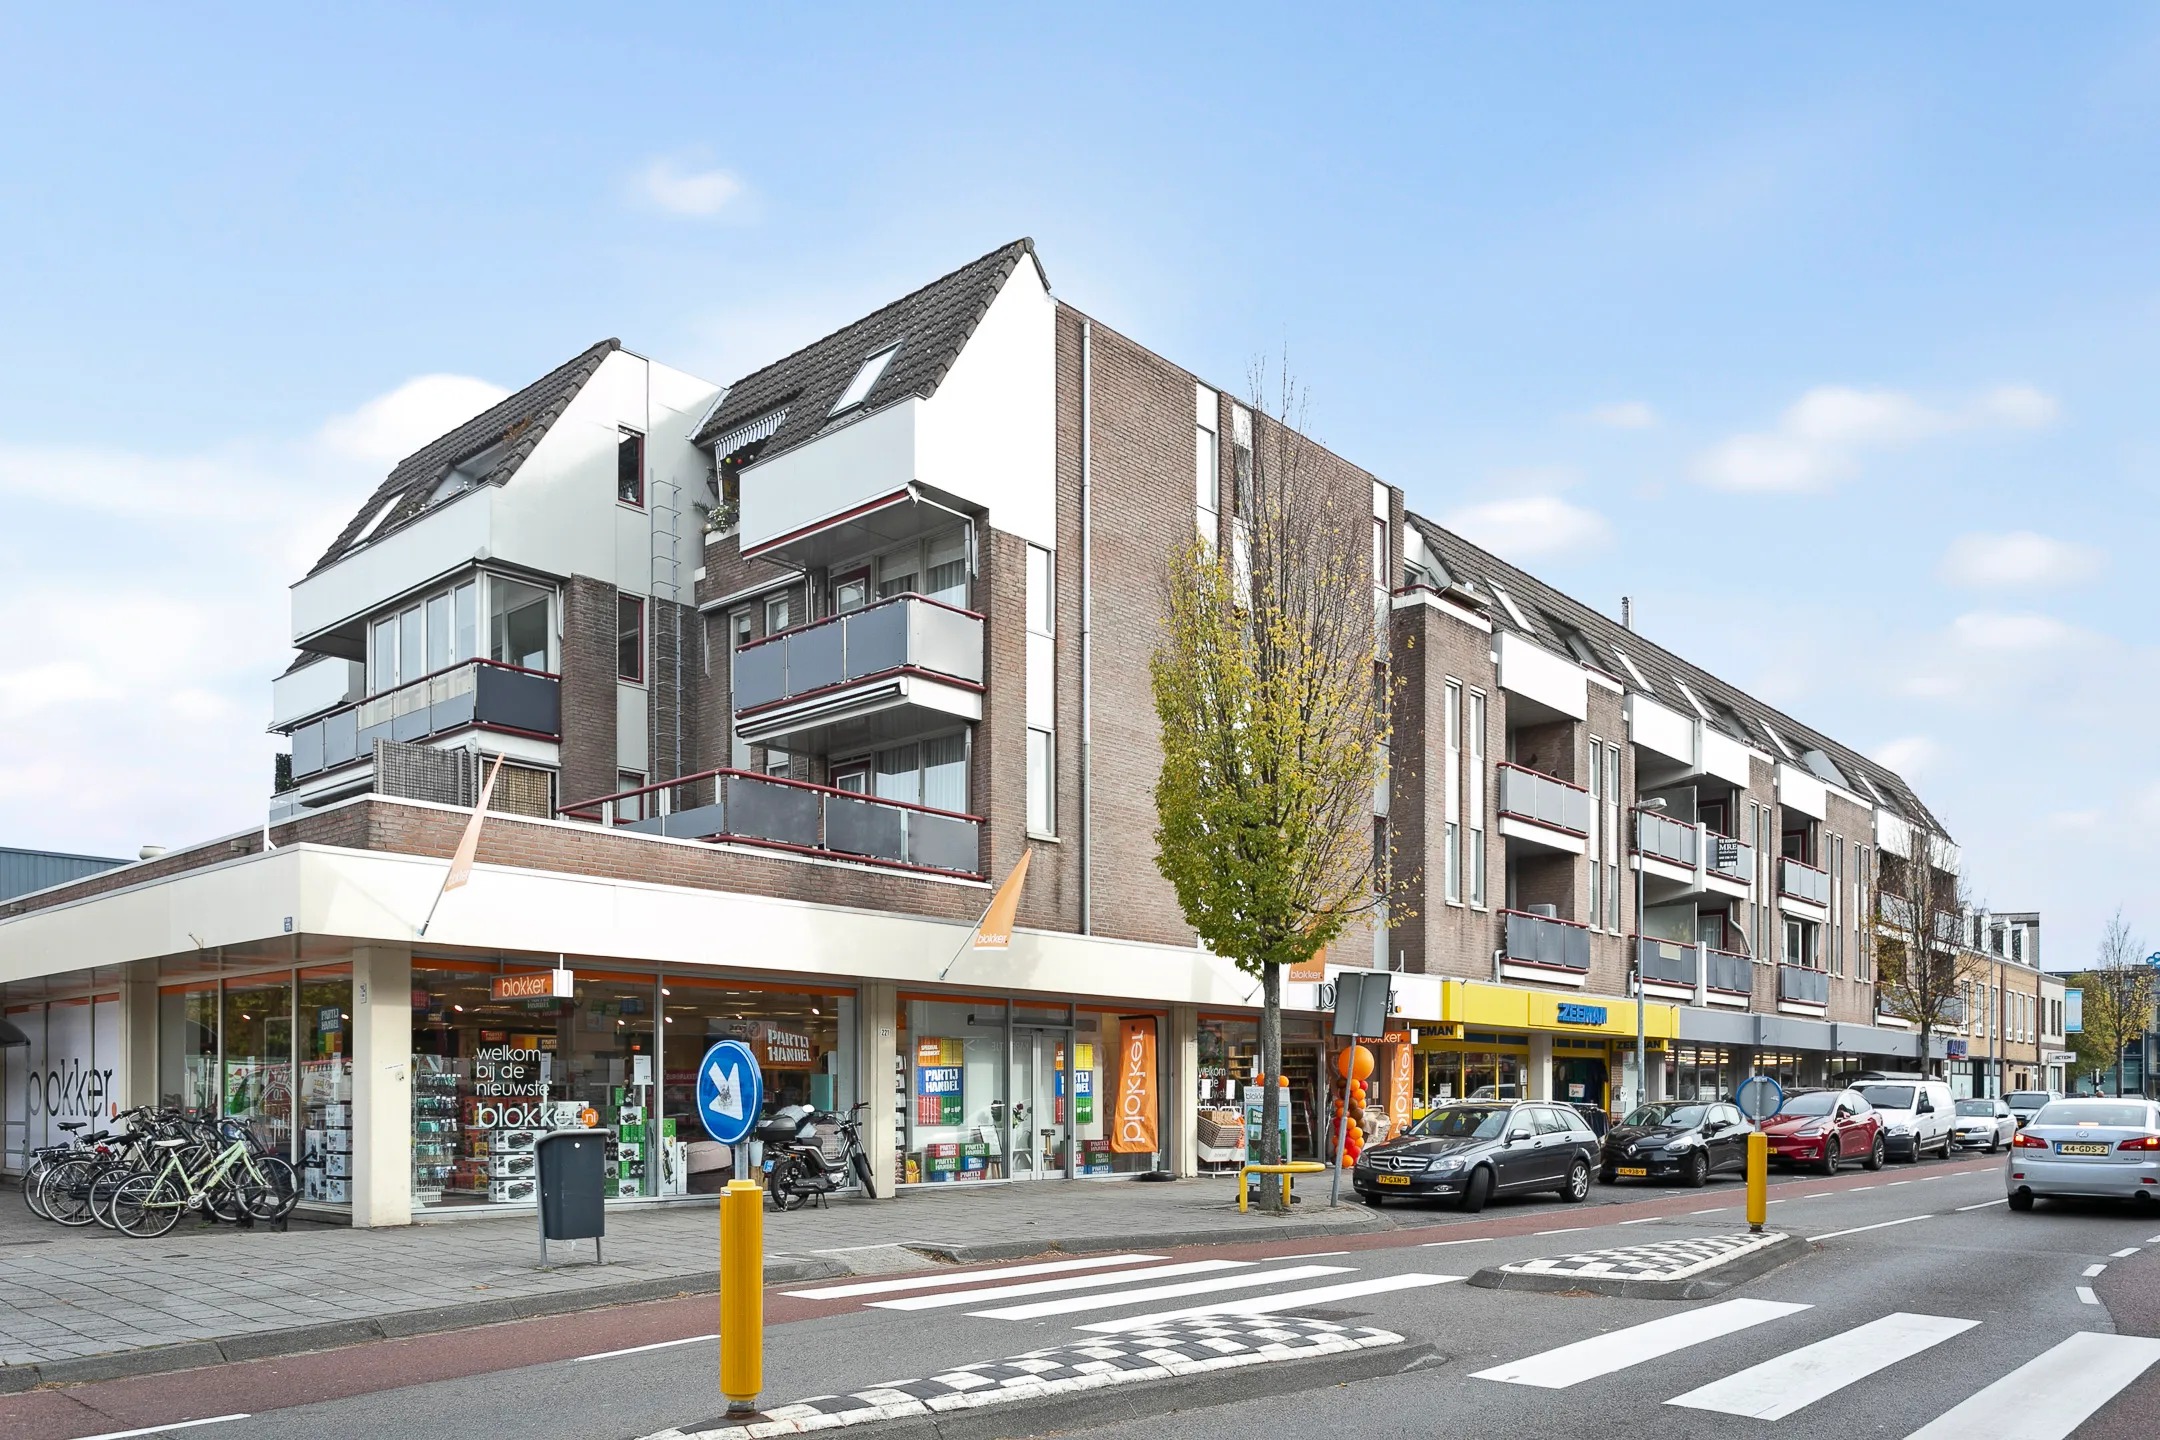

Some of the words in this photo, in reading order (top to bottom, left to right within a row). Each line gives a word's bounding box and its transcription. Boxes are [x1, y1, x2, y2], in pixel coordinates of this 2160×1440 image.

[977, 934, 1008, 944] blokker.
[1290, 970, 1323, 979] blokker.
[502, 977, 547, 997] blokker.
[1558, 1003, 1607, 1024] ZEEMAN
[767, 1028, 809, 1048] PARTIJ
[1616, 1040, 1660, 1049] ZEEAN
[477, 1045, 541, 1061] welkom
[767, 1046, 811, 1062] HANDEL
[477, 1062, 495, 1082] bij
[501, 1063, 524, 1079] de
[926, 1069, 958, 1081] PARTIJ
[477, 1081, 550, 1096] nieuwste
[926, 1081, 959, 1093] HANDEL
[2063, 1144, 2106, 1153] 44-GDS-2
